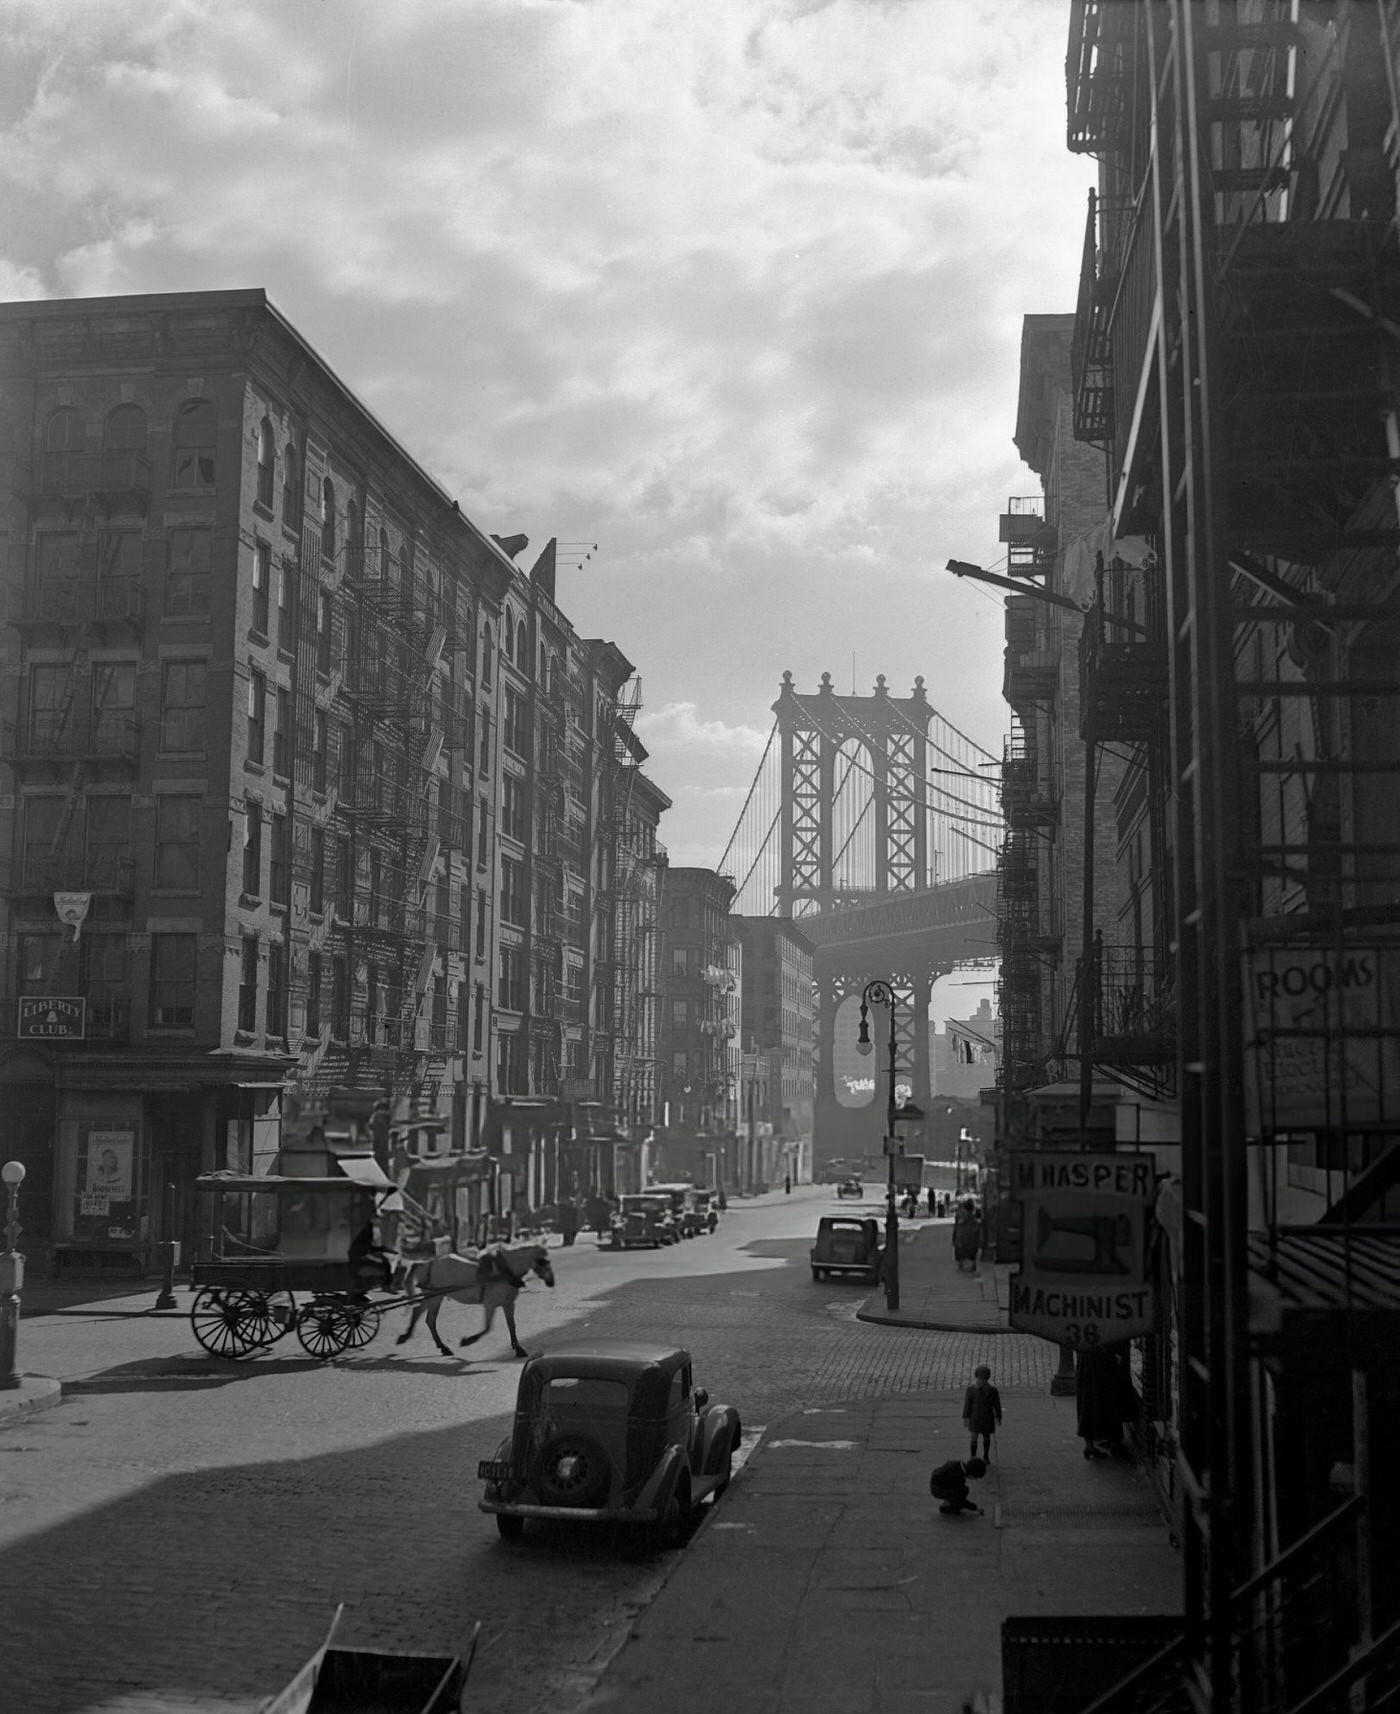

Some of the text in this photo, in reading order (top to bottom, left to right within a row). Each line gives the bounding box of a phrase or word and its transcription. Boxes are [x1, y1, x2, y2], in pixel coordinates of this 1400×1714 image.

[23, 999, 81, 1018] LIBERTY
[1012, 1283, 1149, 1320] MACHINIST
[1064, 1323, 1101, 1346] 36
